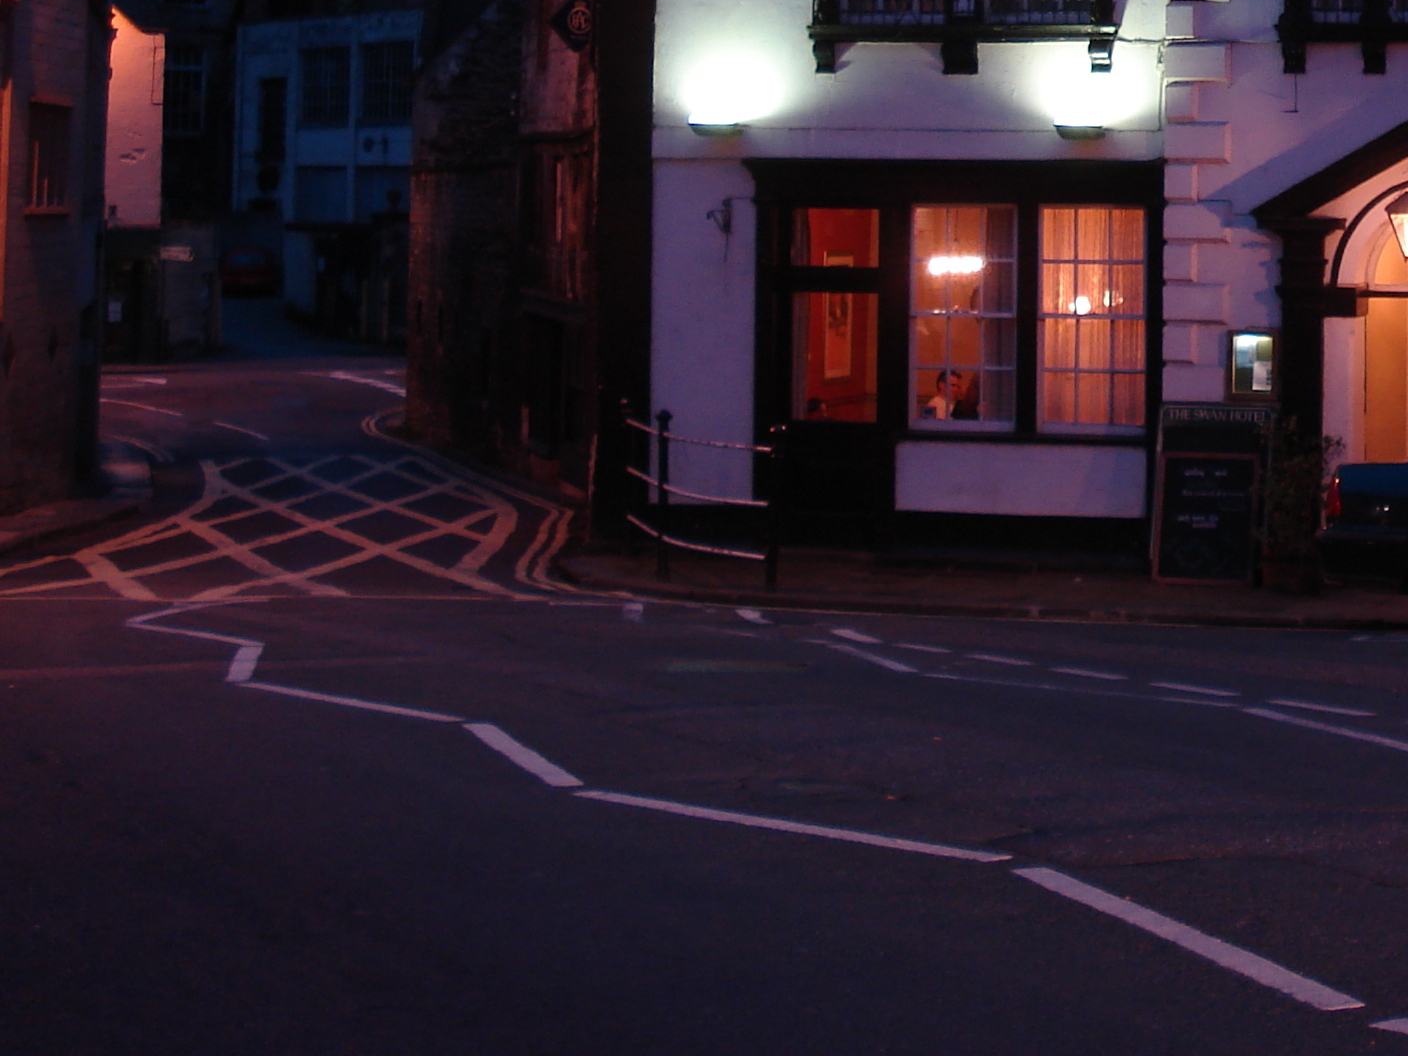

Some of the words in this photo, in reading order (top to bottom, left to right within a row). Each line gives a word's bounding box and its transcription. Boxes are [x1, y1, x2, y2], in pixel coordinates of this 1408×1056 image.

[1168, 408, 1192, 420] THE
[1194, 409, 1227, 421] SWAN
[1229, 410, 1267, 422] HOTEL
